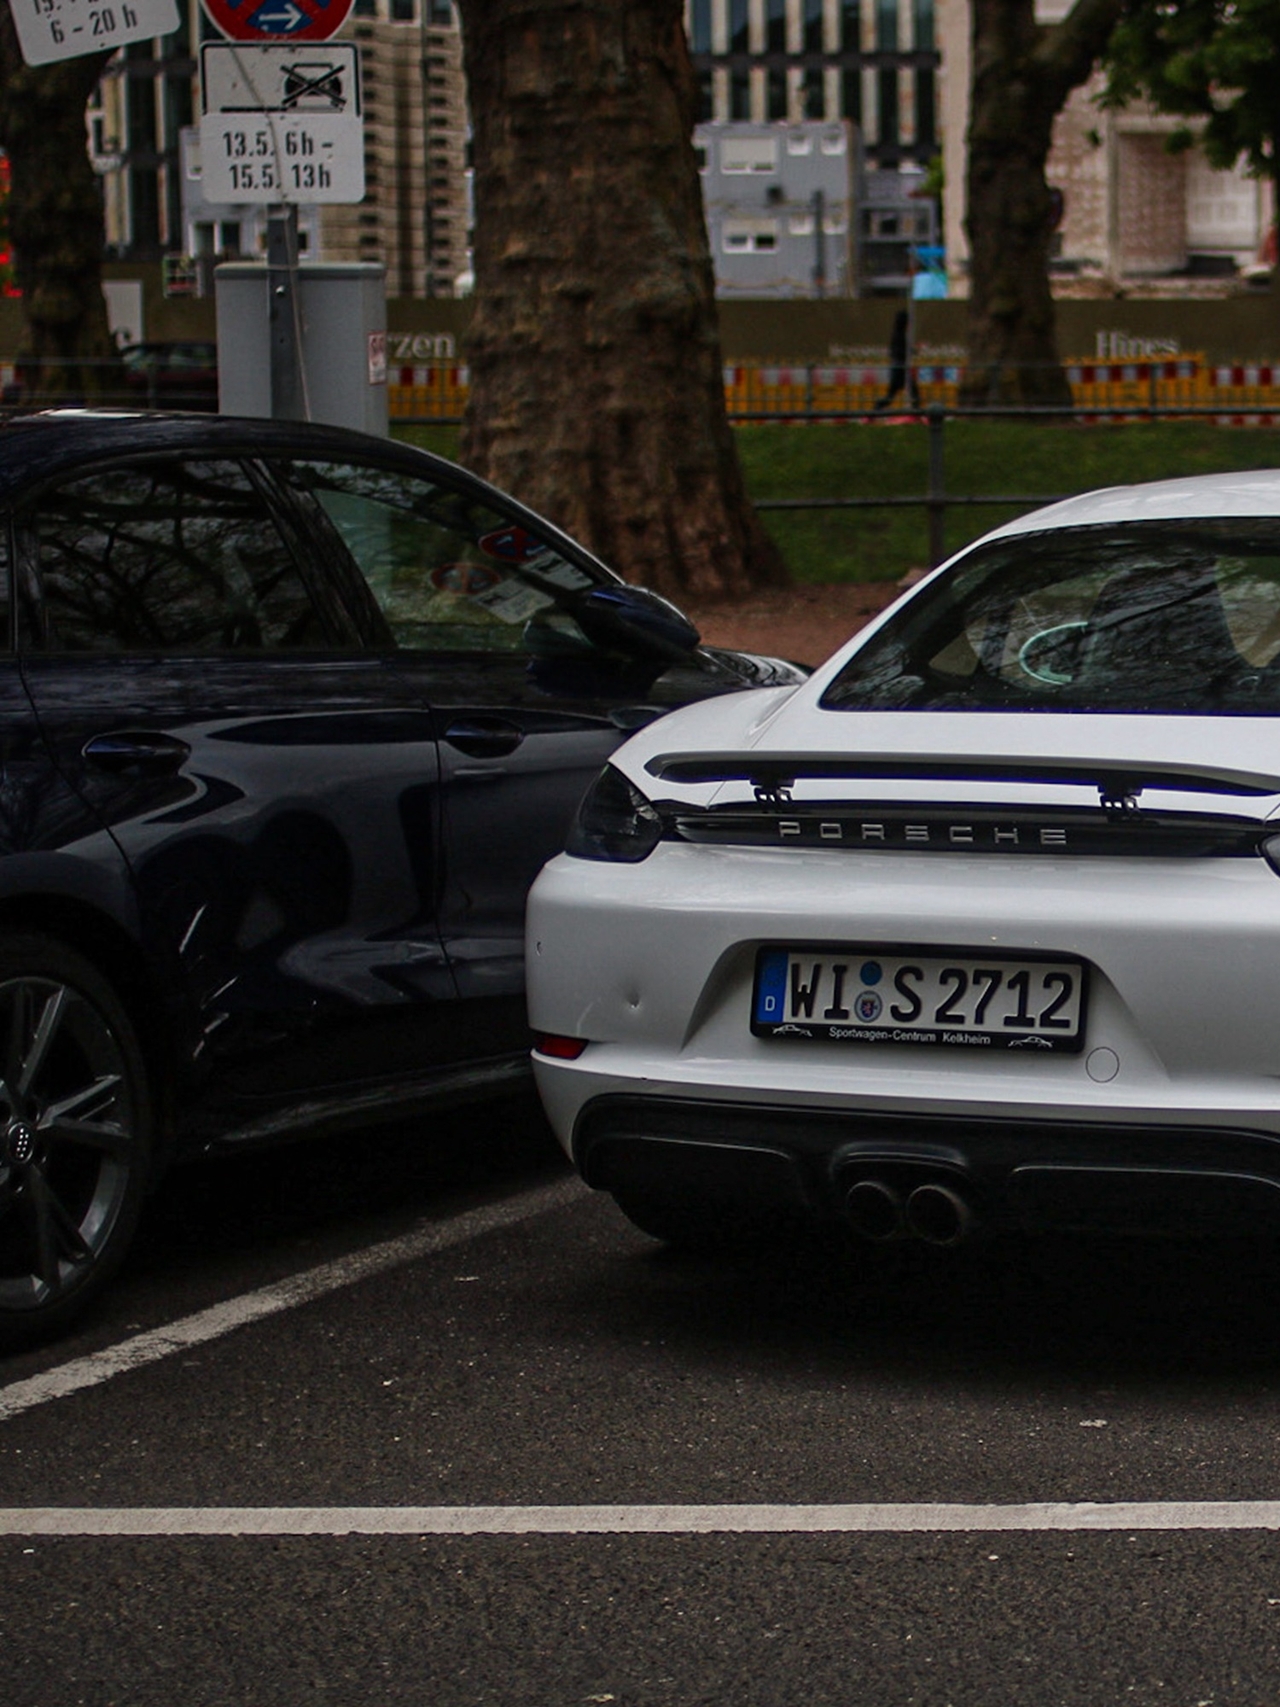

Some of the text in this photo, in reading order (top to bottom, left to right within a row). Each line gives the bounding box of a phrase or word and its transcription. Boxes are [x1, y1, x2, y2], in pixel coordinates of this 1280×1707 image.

[51, 20, 65, 44] 6
[89, 9, 116, 36] 20
[122, 4, 138, 29] h
[222, 131, 275, 157] 13.5.
[229, 164, 331, 189] 15.5. 13h
[1096, 331, 1180, 356] Hines
[779, 821, 1067, 845] PORSCHE
[764, 996, 776, 1012] D
[790, 963, 850, 1020] WI
[828, 1026, 991, 1045] Sportwagen-Centrum Kelkheim
